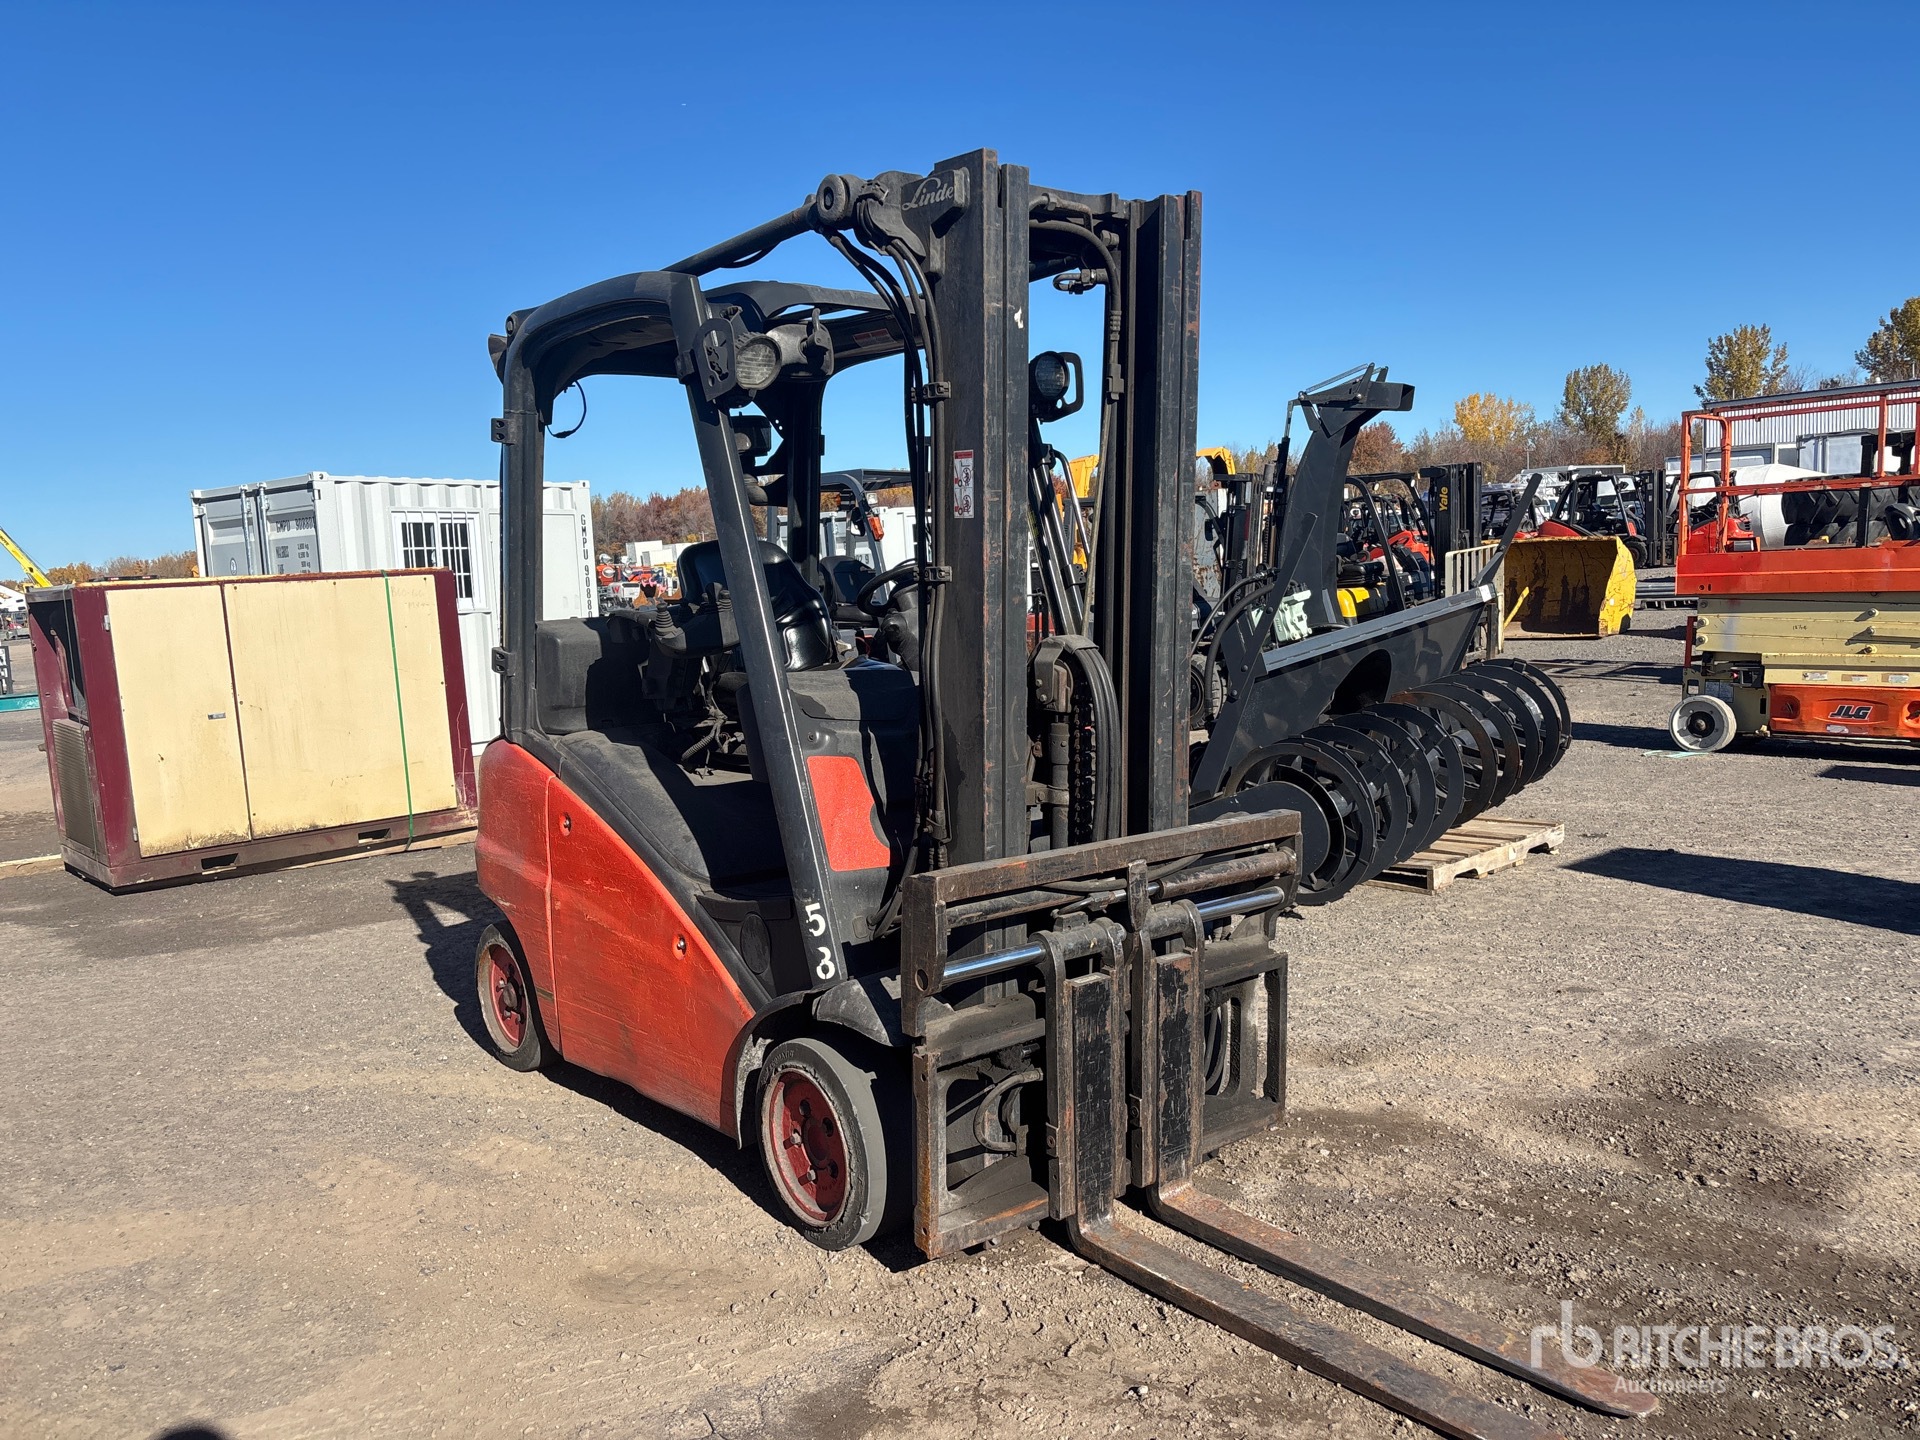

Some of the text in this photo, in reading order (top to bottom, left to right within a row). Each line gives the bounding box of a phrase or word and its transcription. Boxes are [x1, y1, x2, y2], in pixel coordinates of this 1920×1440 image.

[902, 177, 954, 211] Linde
[1439, 487, 1449, 512] Yale
[580, 514, 588, 560] GMPU
[1828, 705, 1873, 720] JLG
